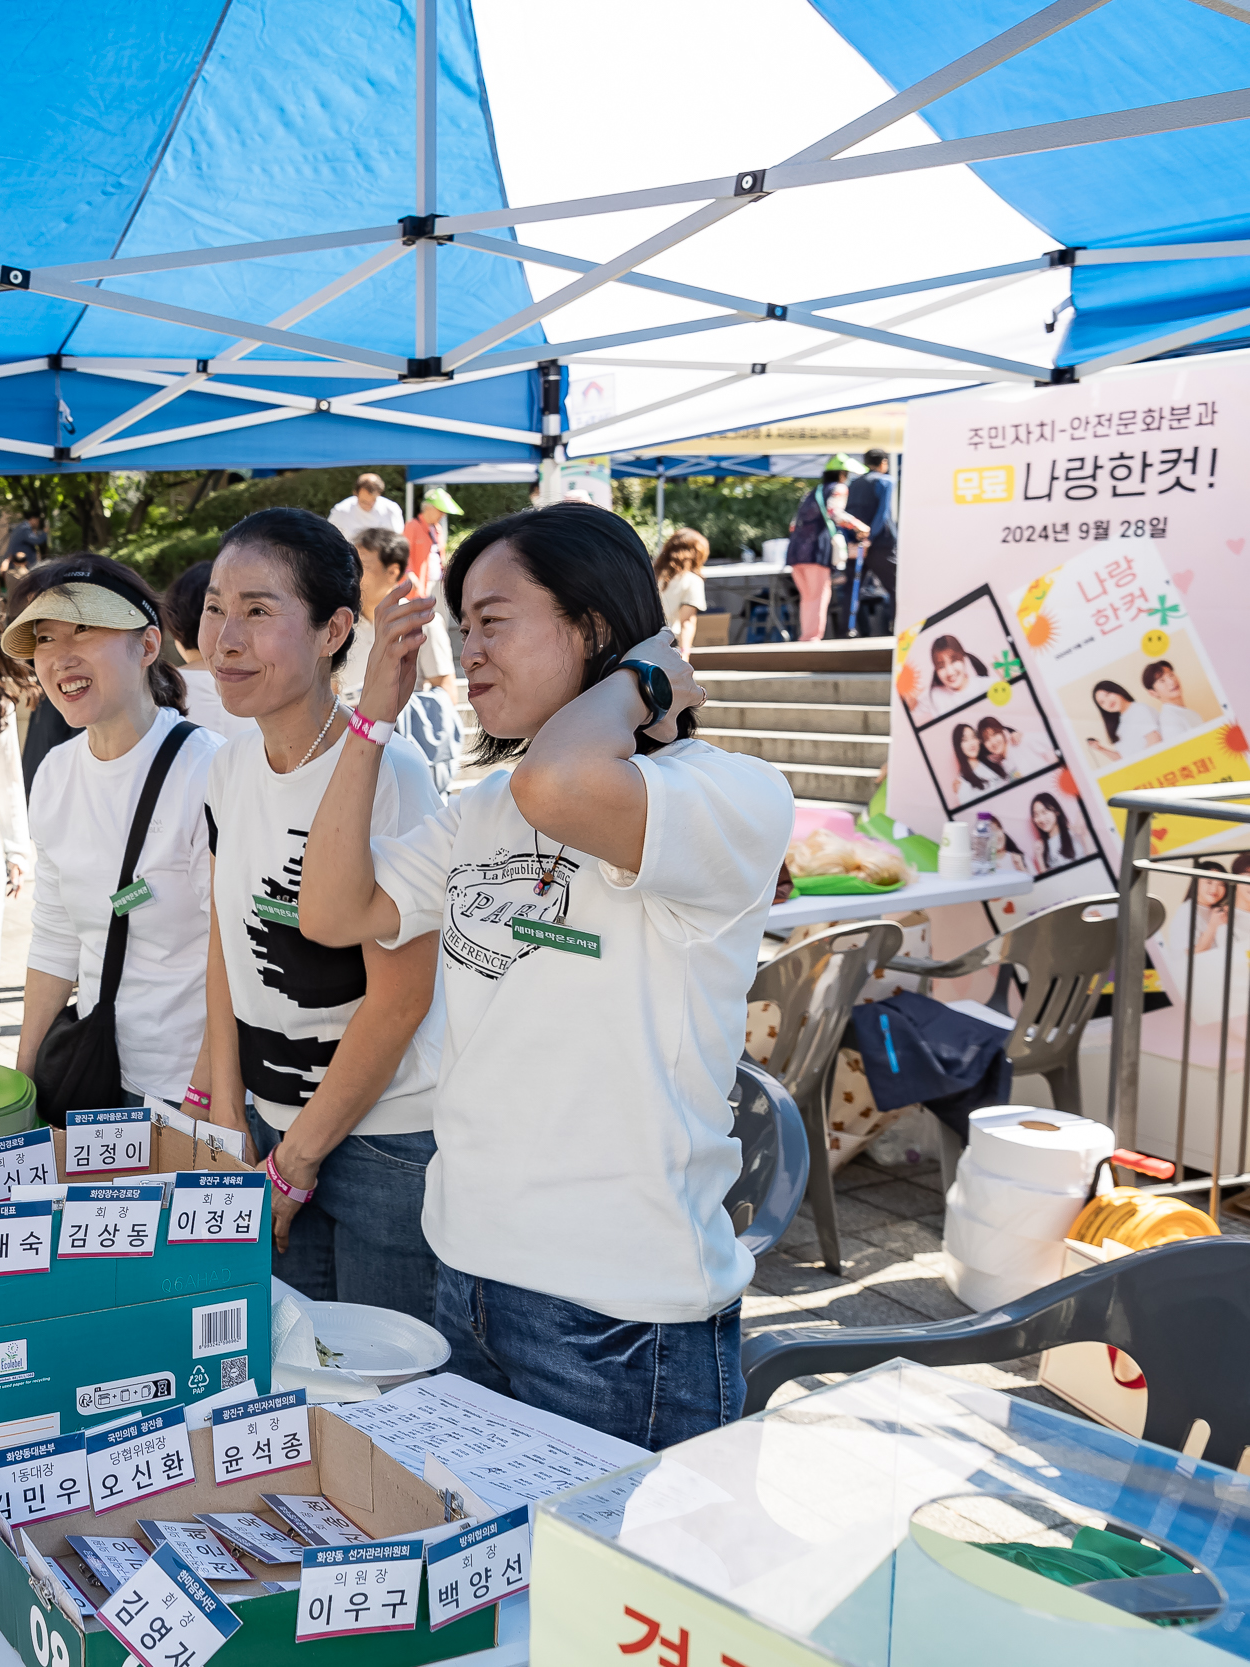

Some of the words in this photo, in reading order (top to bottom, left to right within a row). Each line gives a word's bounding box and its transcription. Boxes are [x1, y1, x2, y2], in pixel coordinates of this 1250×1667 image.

[967, 400, 1218, 450] 주민자치-안전문화분과
[955, 468, 1008, 503] 무료
[1023, 446, 1218, 503] 나랑한컷!
[1000, 521, 1070, 545] 2024년
[1078, 519, 1111, 541] 9월
[1119, 516, 1168, 540] 28일
[1076, 555, 1137, 604] 나랑
[1091, 587, 1155, 637] 한컷
[482, 870, 499, 881] La
[444, 925, 461, 949] THE
[460, 943, 509, 971] FRENCH
[514, 925, 598, 951] 새마을작은도서관
[74, 1113, 95, 1123] 광진구
[96, 1112, 128, 1122] 새마을문고
[130, 1111, 144, 1120] 회장
[198, 1176, 220, 1186] 광진구
[222, 1176, 244, 1186] 체육회
[89, 1189, 141, 1199] 화양장수경로당
[0, 1358, 23, 1370] Ecolabel
[192, 1386, 205, 1395] PAP
[194, 1374, 203, 1383] 20
[222, 1406, 245, 1421] 광진구
[246, 1394, 296, 1415] 주민자치협의회
[107, 1425, 138, 1443] 국민의힘
[140, 1416, 164, 1432] 광진을
[5, 1442, 56, 1462] 화양동대본부
[109, 1435, 167, 1466] 당협위원장
[11, 1462, 55, 1484] 1동대장
[459, 1522, 498, 1547] 방위협의회
[316, 1549, 344, 1564] 화양동
[348, 1544, 410, 1561] 선거관리위원회
[176, 1569, 217, 1614] 한마음봉사단
